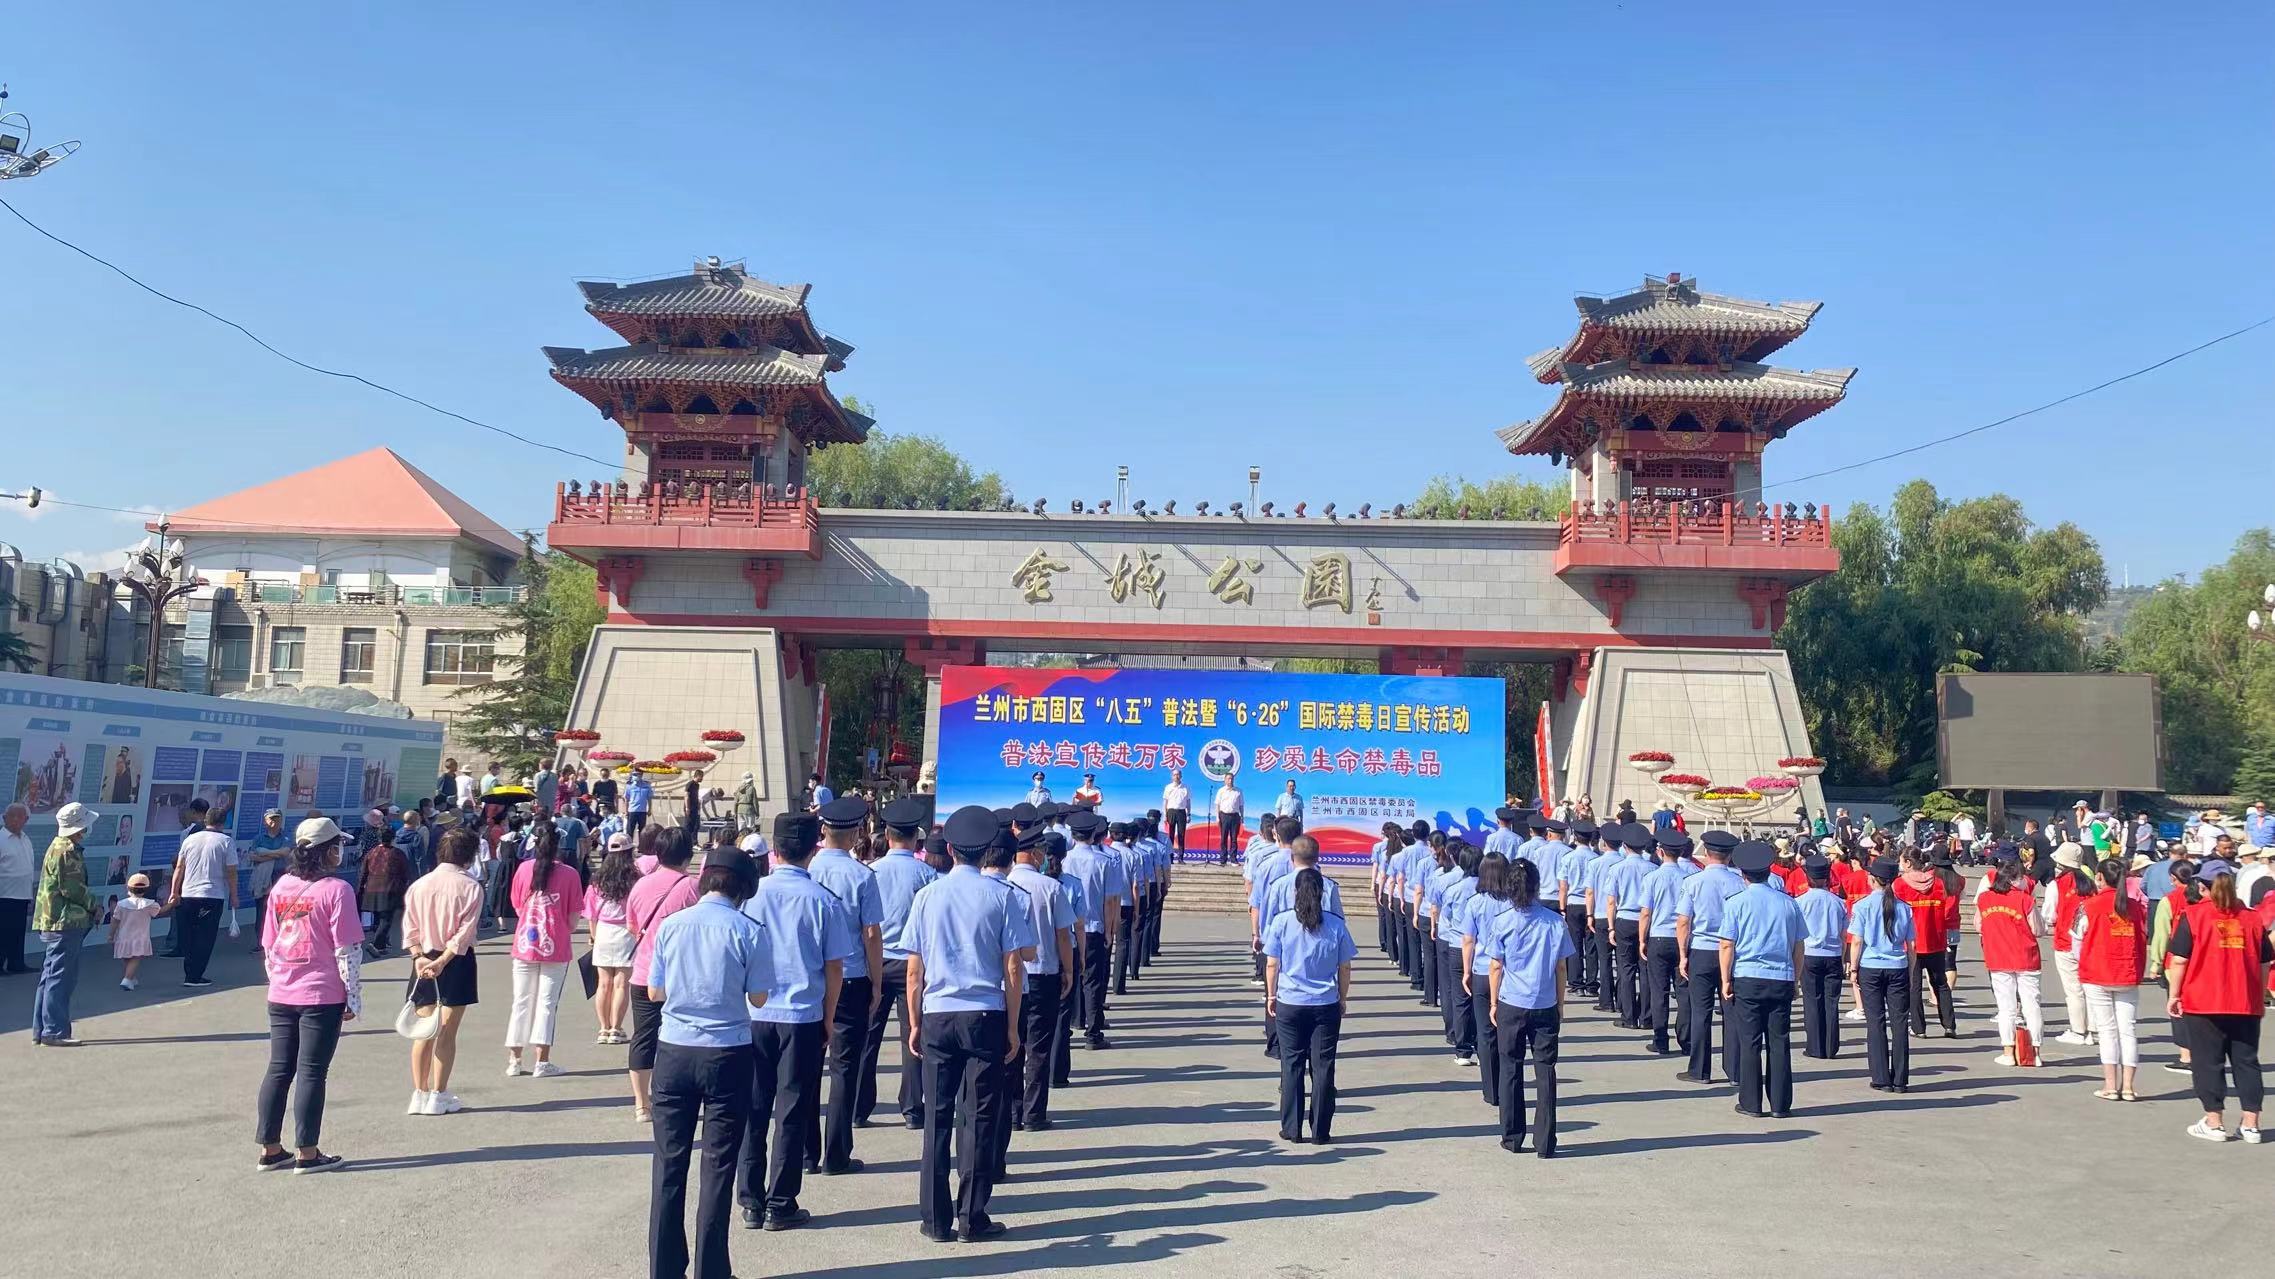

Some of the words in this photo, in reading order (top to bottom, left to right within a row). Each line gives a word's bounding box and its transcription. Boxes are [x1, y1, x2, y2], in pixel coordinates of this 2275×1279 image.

[1001, 739, 1187, 769] 普法宣传进万家
[1254, 745, 1441, 777] 珍爱生命禁毒品
[1312, 796, 1415, 807] 兰州市西固区禁毒委员会
[1312, 807, 1415, 817] 兰州市西固区司法局
